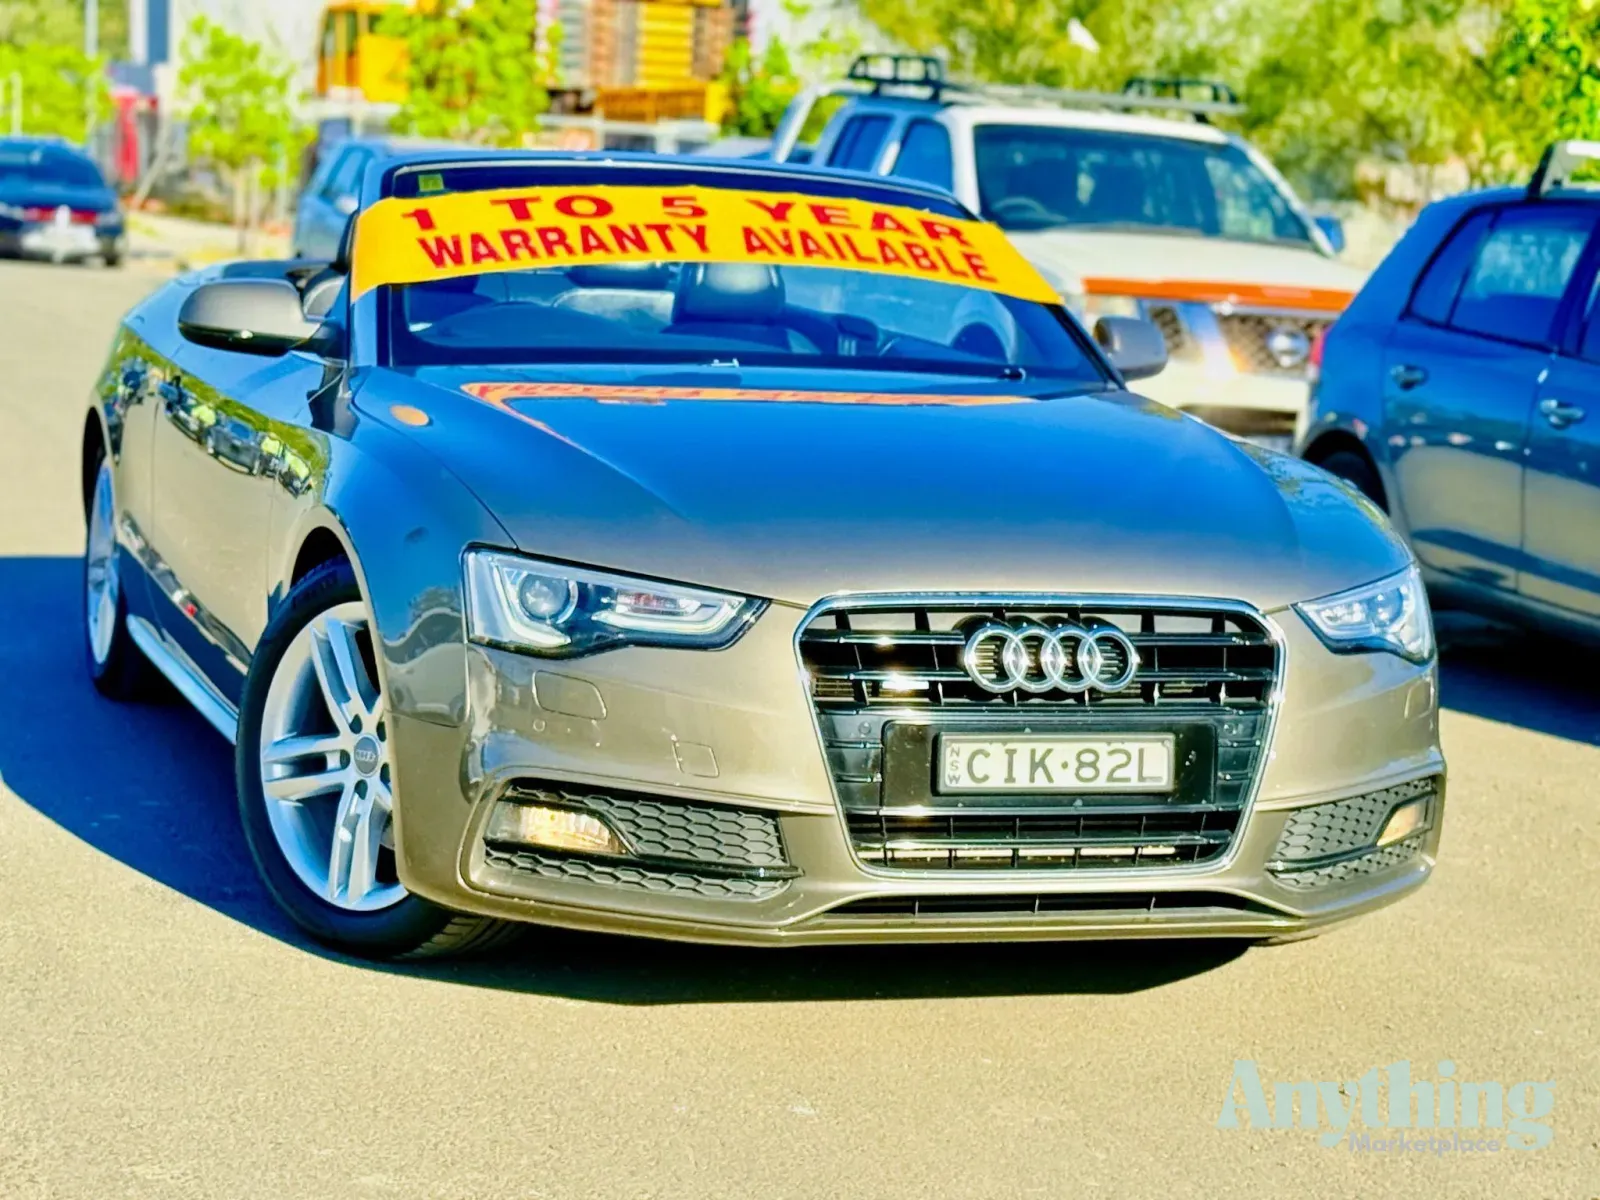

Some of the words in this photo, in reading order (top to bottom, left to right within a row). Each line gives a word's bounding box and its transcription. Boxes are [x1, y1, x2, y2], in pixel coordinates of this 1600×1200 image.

[402, 208, 437, 231] 1
[490, 195, 614, 221] TO
[661, 196, 708, 219] 5
[746, 199, 973, 248] YEAR
[418, 224, 711, 269] WARRANTY
[742, 226, 998, 283] AVAILABLE
